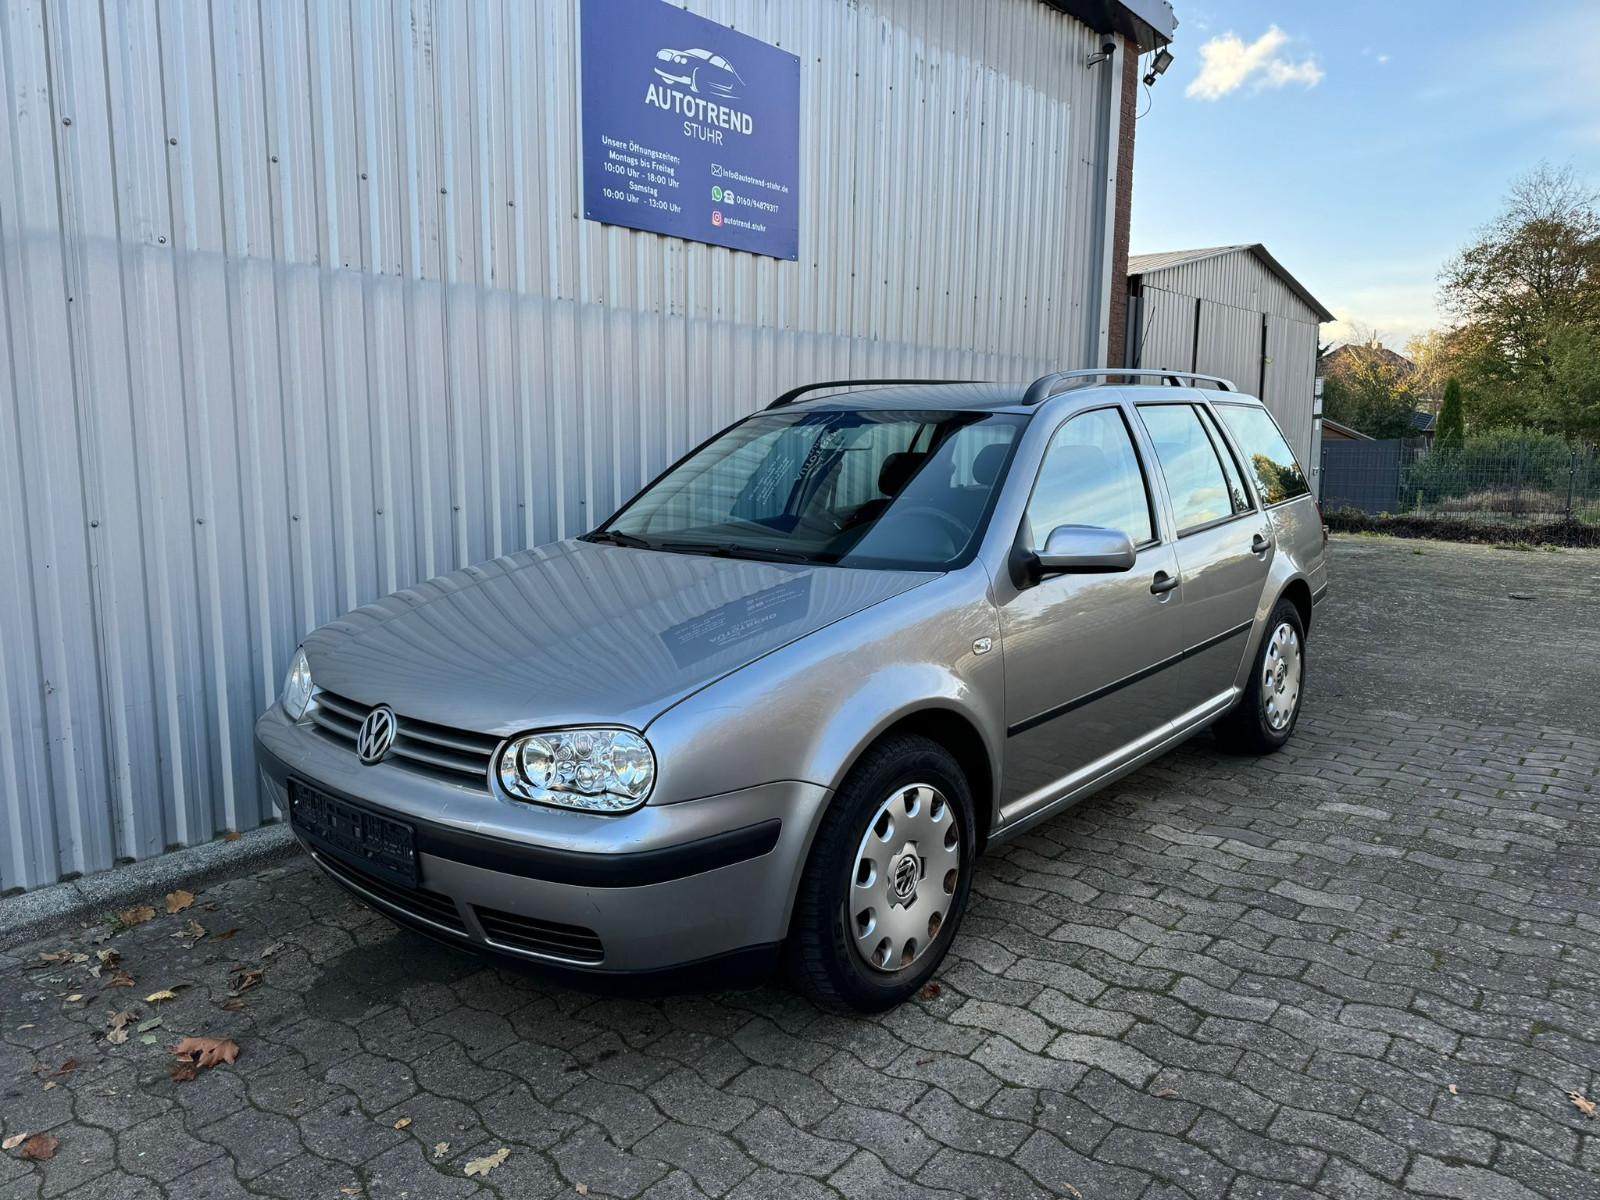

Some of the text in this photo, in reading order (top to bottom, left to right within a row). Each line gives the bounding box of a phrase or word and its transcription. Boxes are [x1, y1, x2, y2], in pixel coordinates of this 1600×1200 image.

[644, 83, 753, 135] AUTOTREND
[602, 135, 627, 149] Unsere
[683, 121, 723, 146] STUHR
[603, 162, 625, 175] 10:00
[627, 167, 640, 178] Uhr
[647, 173, 666, 185] 18:00
[668, 177, 680, 188] Uhr
[609, 150, 675, 176] Montags bis Freitag
[603, 188, 625, 200] 10:00
[626, 193, 640, 204] Uhr
[649, 198, 668, 210] 13:00
[669, 203, 681, 213] Uhr
[629, 181, 658, 197] Samstag
